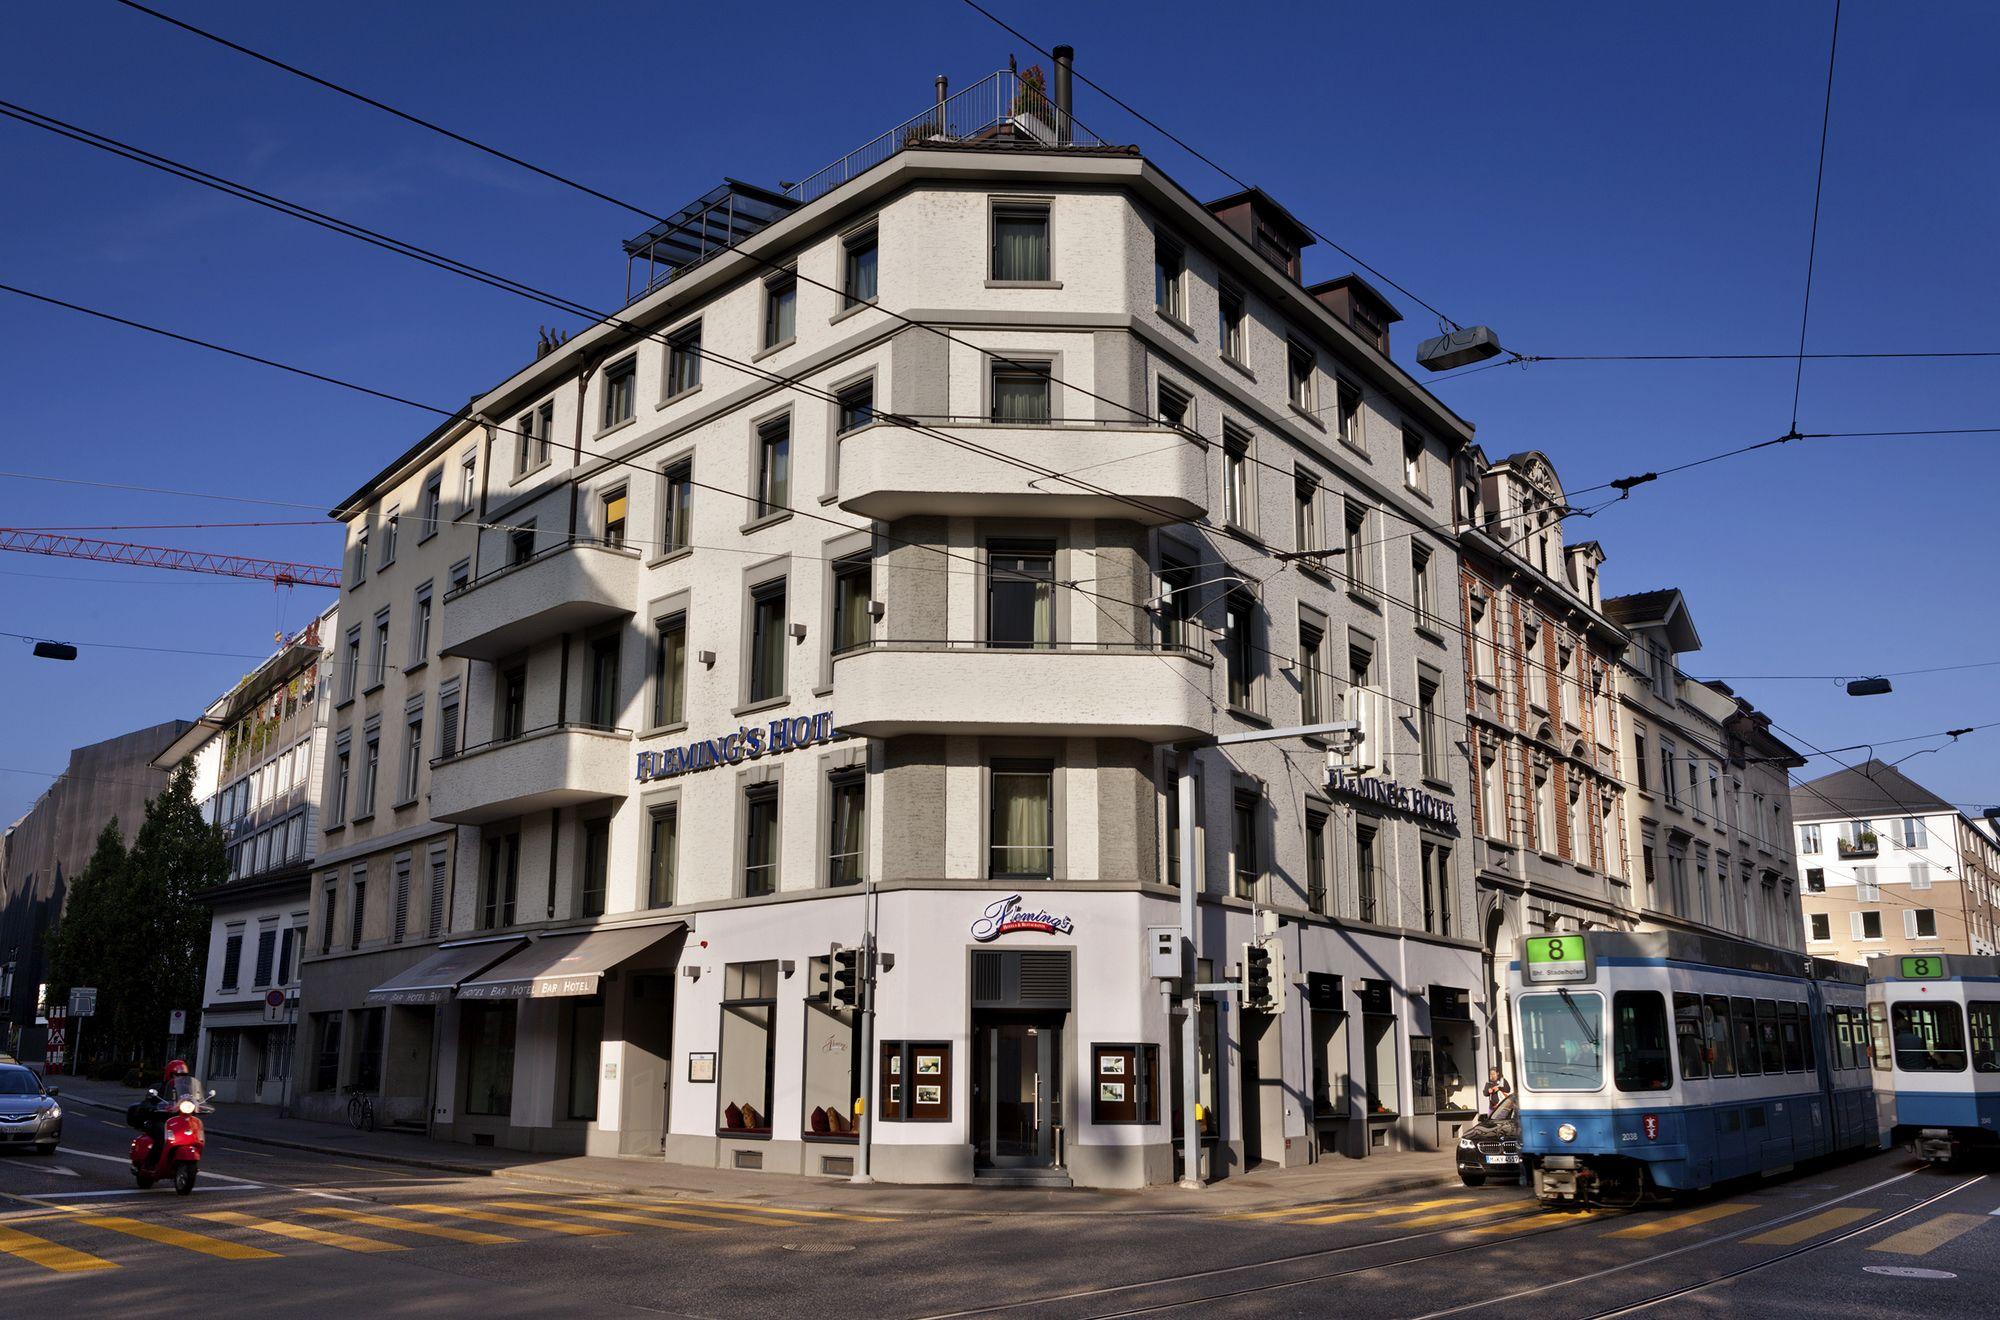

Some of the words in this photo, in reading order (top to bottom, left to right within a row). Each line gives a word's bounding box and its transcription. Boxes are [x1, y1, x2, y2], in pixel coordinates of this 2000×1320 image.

[635, 726, 766, 781] FLEMING'S
[970, 894, 1071, 941] Fleming's
[1548, 939, 1564, 960] 8
[1914, 958, 1930, 975] 8
[511, 982, 536, 996] HOTEL
[541, 982, 558, 994] BAR
[564, 980, 590, 992] HOTEL
